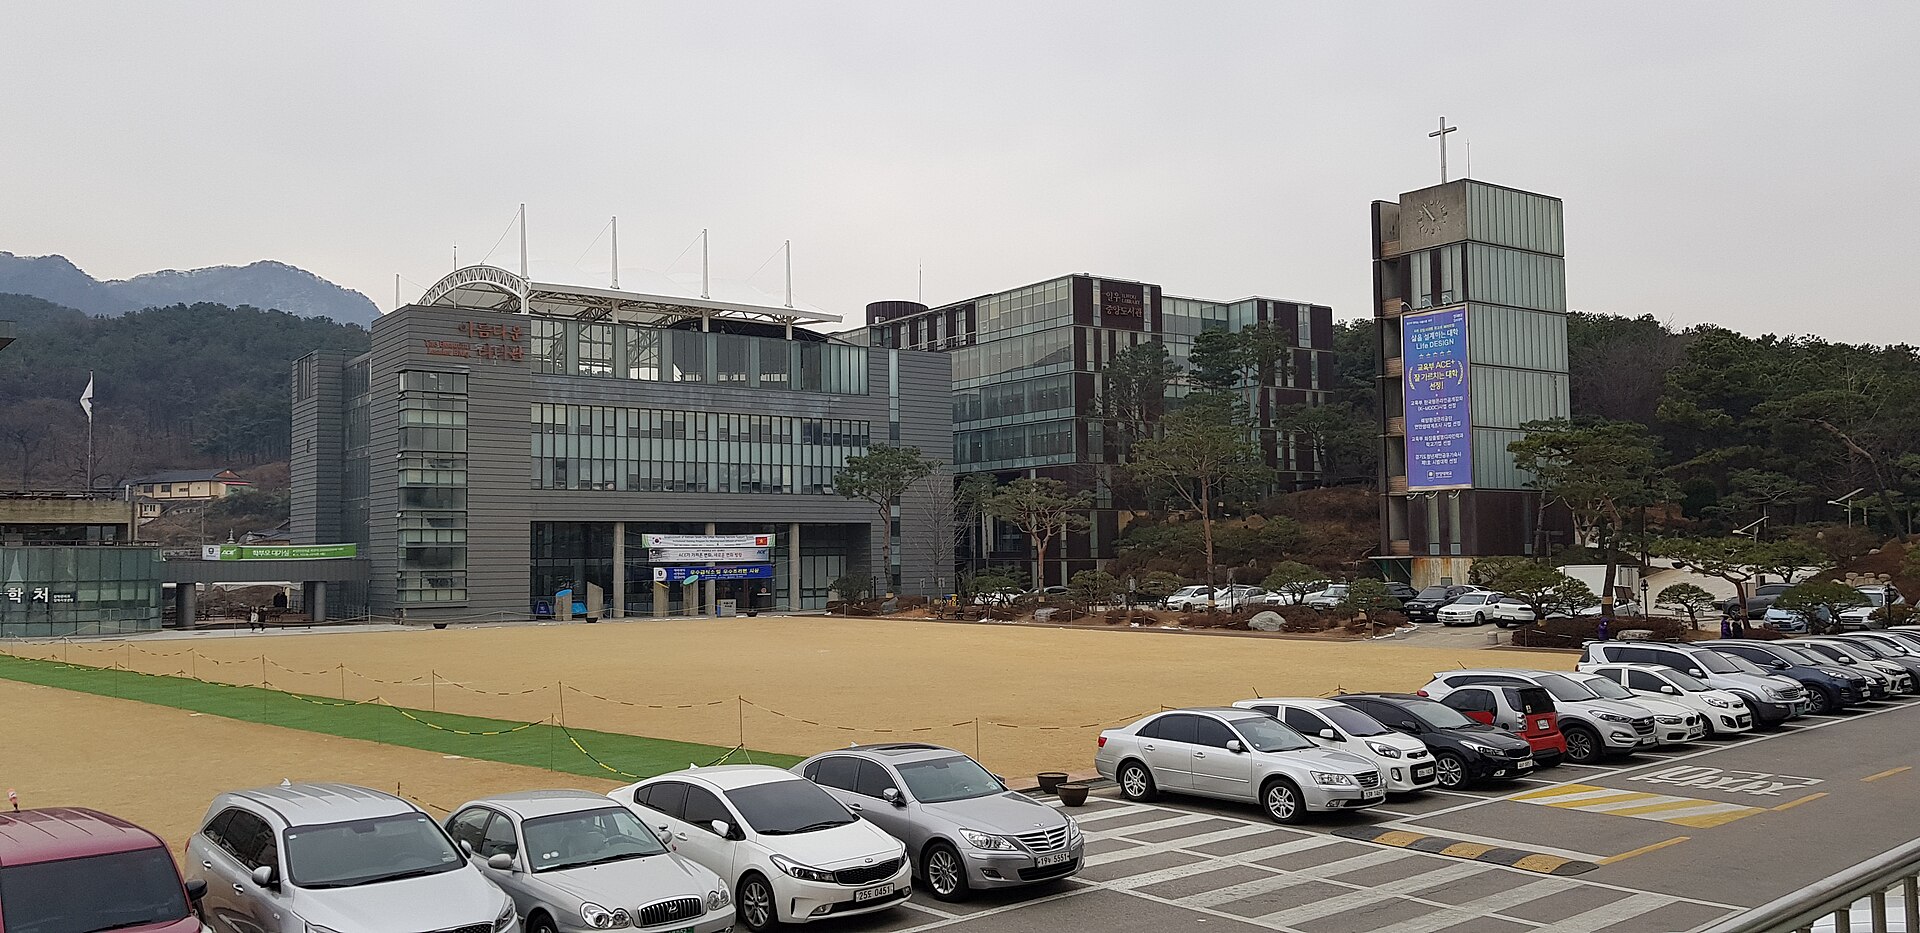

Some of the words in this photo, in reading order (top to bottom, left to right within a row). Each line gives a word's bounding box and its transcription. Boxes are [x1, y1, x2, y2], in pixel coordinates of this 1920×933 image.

[1106, 305, 1142, 317] 중앙도서관
[459, 320, 521, 341] 아름다운
[1447, 328, 1459, 337] 대학
[1430, 338, 1454, 347] DESIGN
[1417, 362, 1434, 371] 교육부
[1421, 372, 1445, 381] 가르치는
[1446, 369, 1458, 378] 대학
[271, 549, 289, 557] 대기실
[1627, 765, 1825, 796] 천천히
[1054, 853, 1067, 863] 5551
[874, 886, 890, 896] 0451
